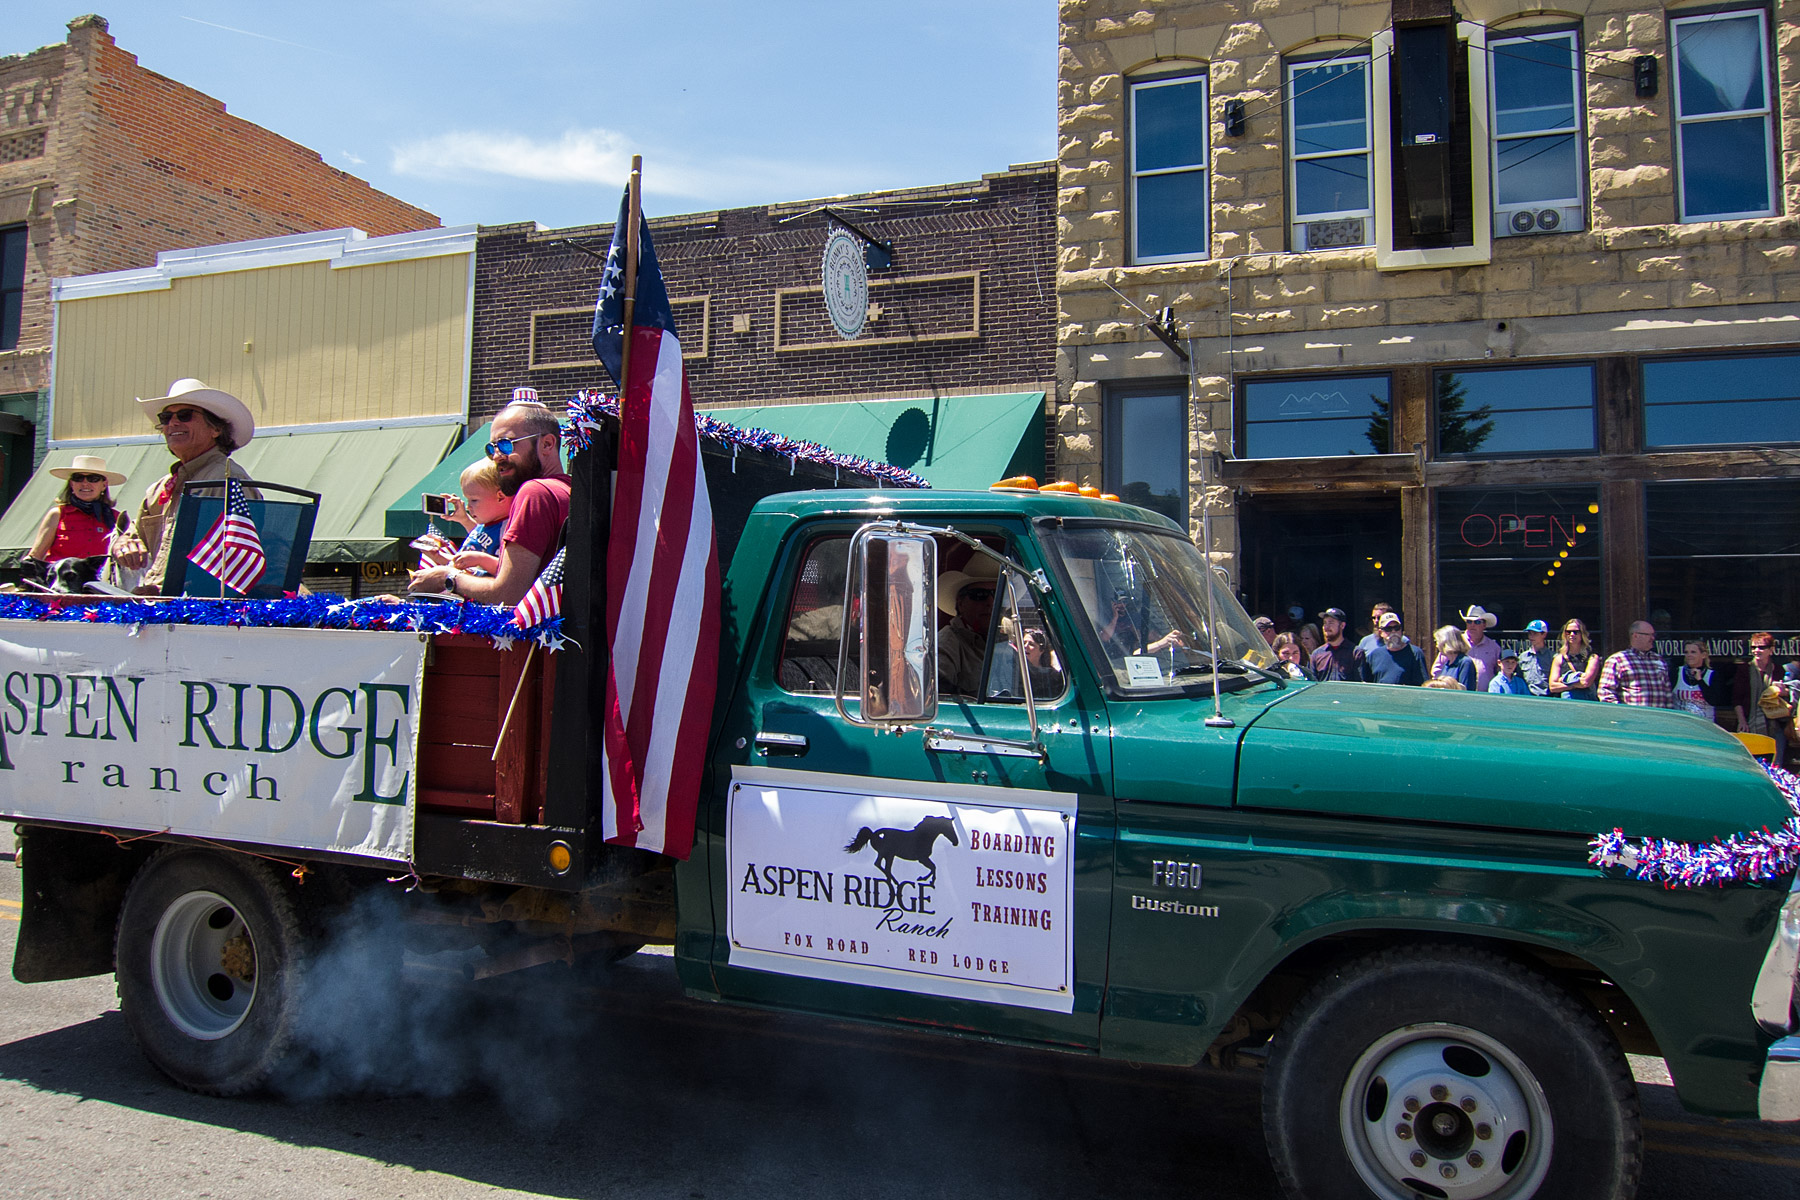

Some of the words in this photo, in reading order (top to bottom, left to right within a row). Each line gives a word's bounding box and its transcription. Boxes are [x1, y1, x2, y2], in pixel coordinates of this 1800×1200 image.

[830, 244, 849, 271] BUNNY'S
[1461, 513, 1576, 548] OPEN
[1655, 639, 1685, 656] WORL
[1706, 639, 1744, 656] AMOUS
[0, 671, 145, 770] SPEN
[179, 681, 411, 806] RIDGE
[62, 760, 281, 802] ranch
[970, 829, 1055, 858] BOARDING
[741, 863, 833, 903] ASPEN
[844, 874, 935, 915] RIDGE
[976, 867, 1048, 894] LESSONS
[971, 902, 1052, 931] TRAINING
[1131, 895, 1219, 917] Custom
[876, 907, 953, 939] Ranch
[784, 932, 814, 948] FOX
[827, 938, 870, 954] ROAD
[908, 948, 939, 965] RED
[953, 954, 1010, 974] LODGE
